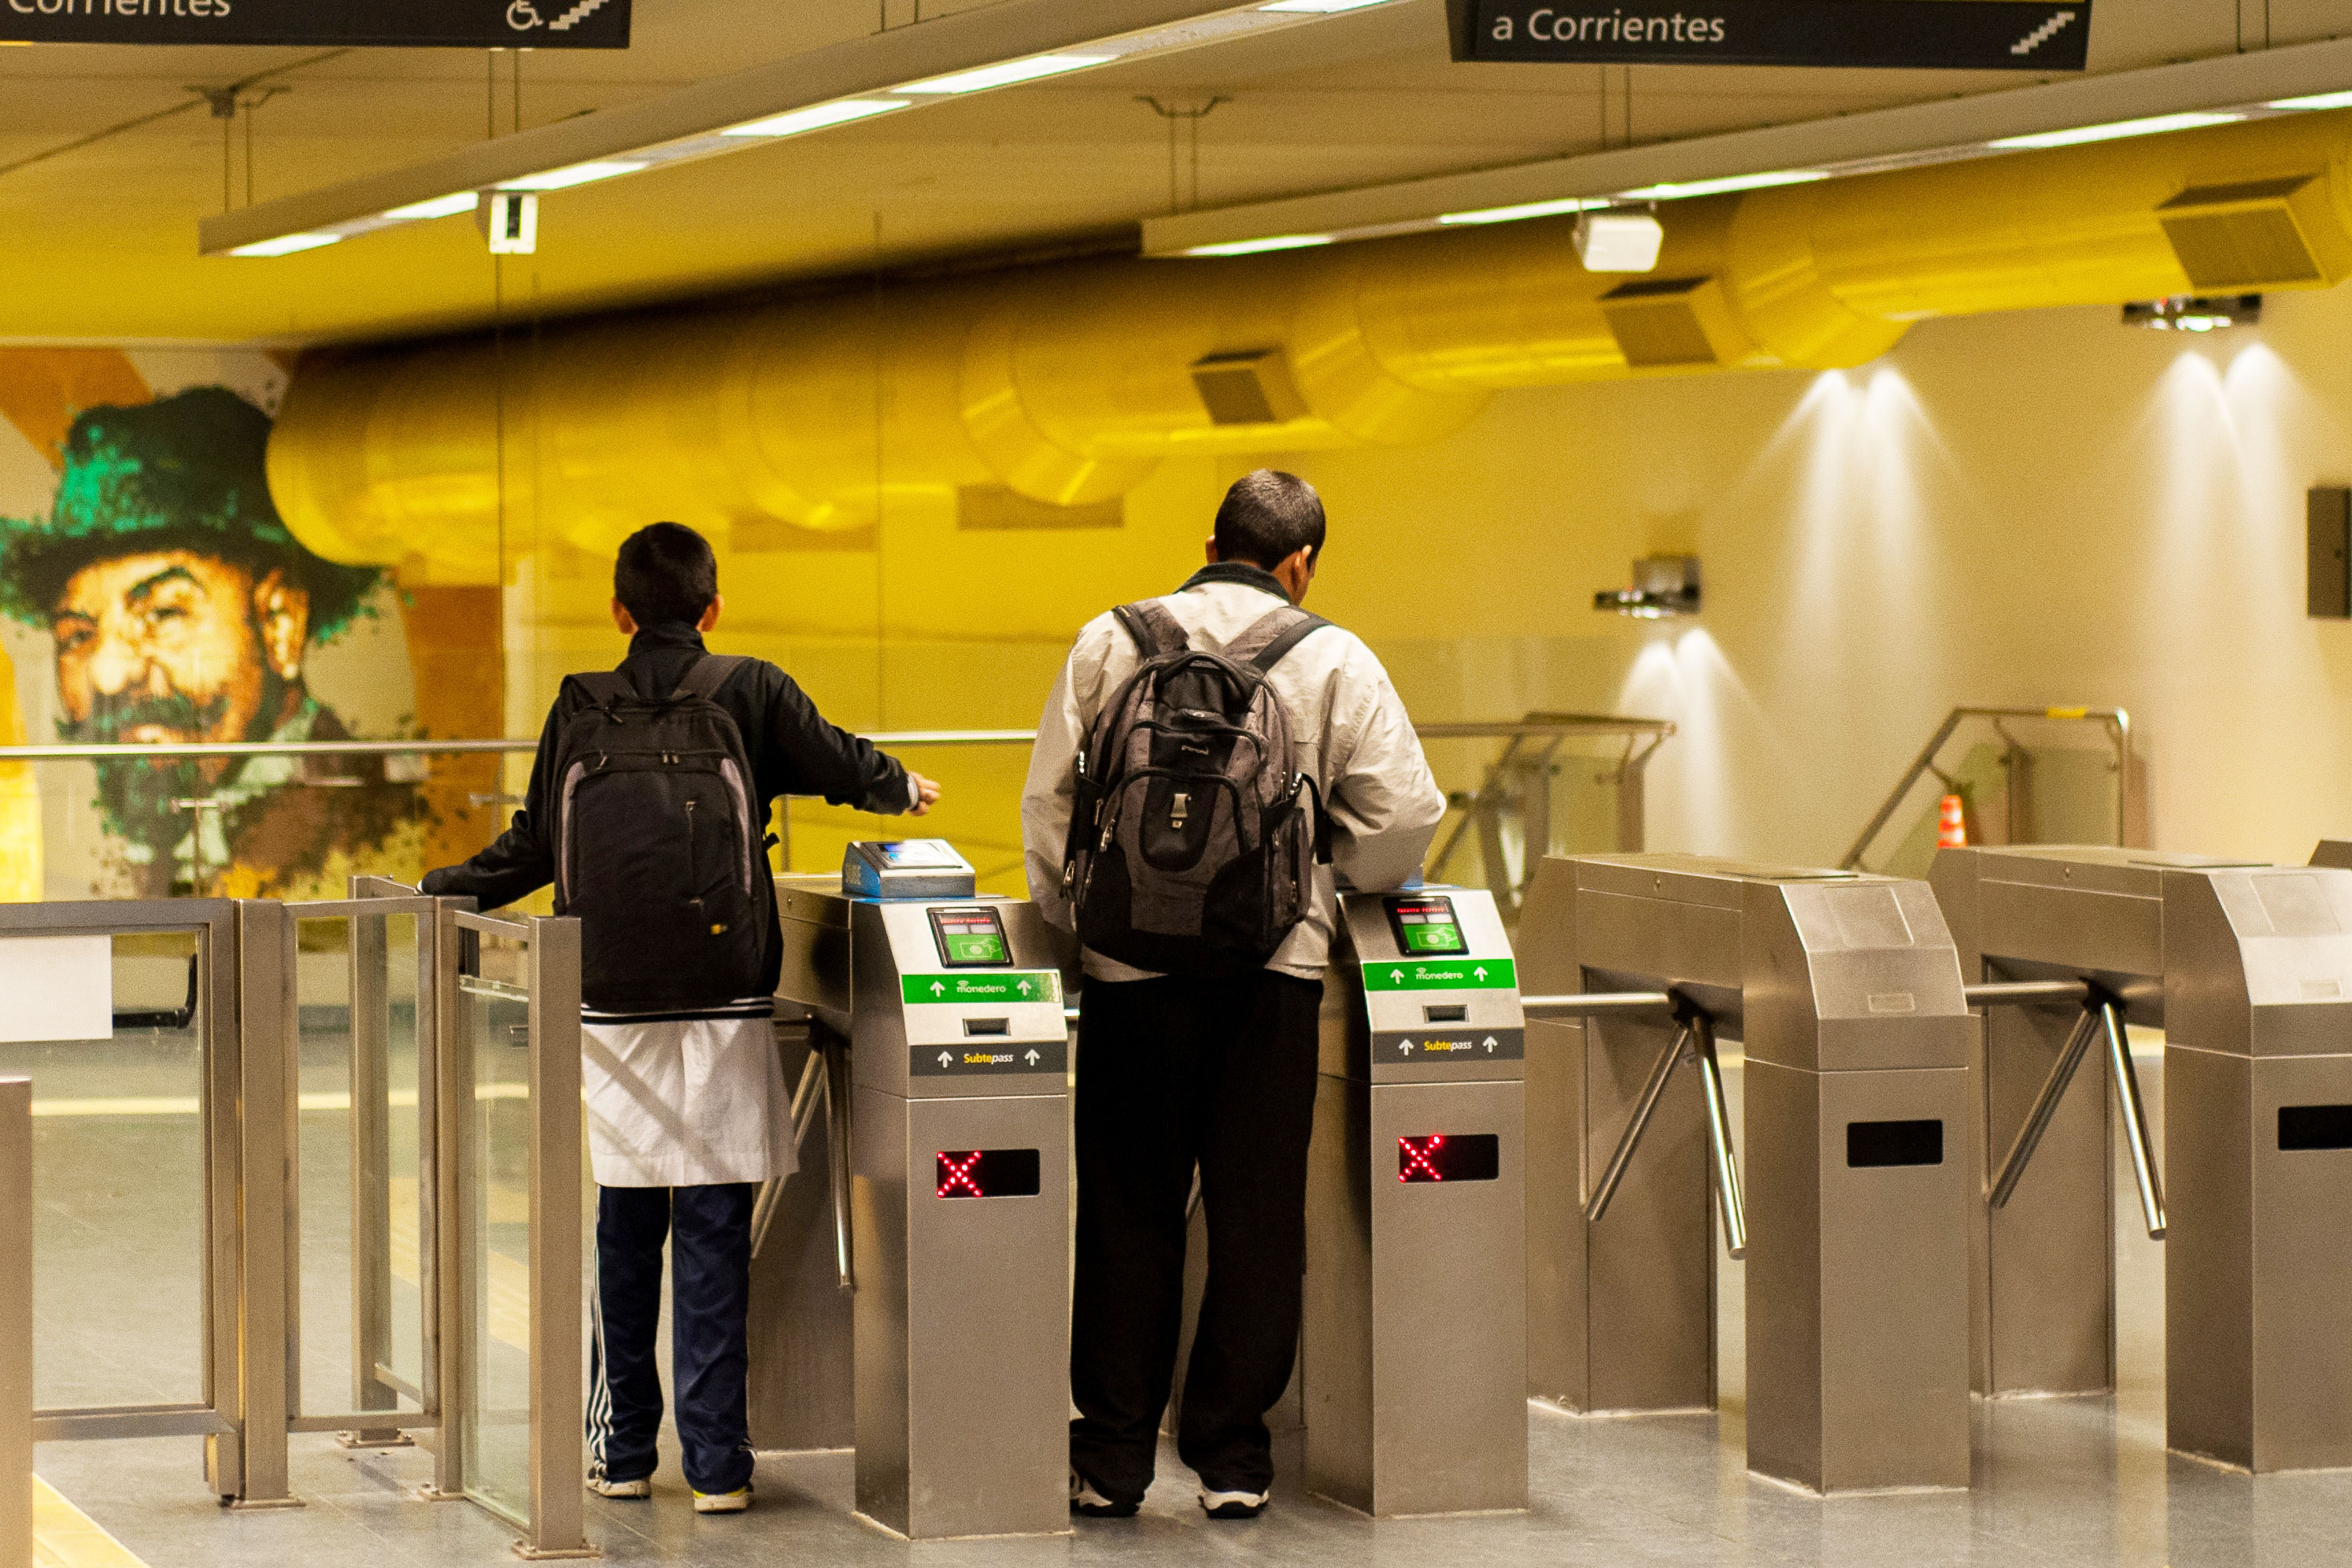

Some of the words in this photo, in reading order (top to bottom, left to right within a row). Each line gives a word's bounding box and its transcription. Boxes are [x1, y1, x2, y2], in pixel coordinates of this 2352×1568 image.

[1492, 16, 1513, 40] a
[1528, 8, 1725, 41] Corrientes
[1416, 971, 1464, 980] monedero
[956, 984, 1007, 993] monedero
[1424, 1041, 1473, 1052] Subtepass
[963, 1053, 1014, 1065] Subtepass
